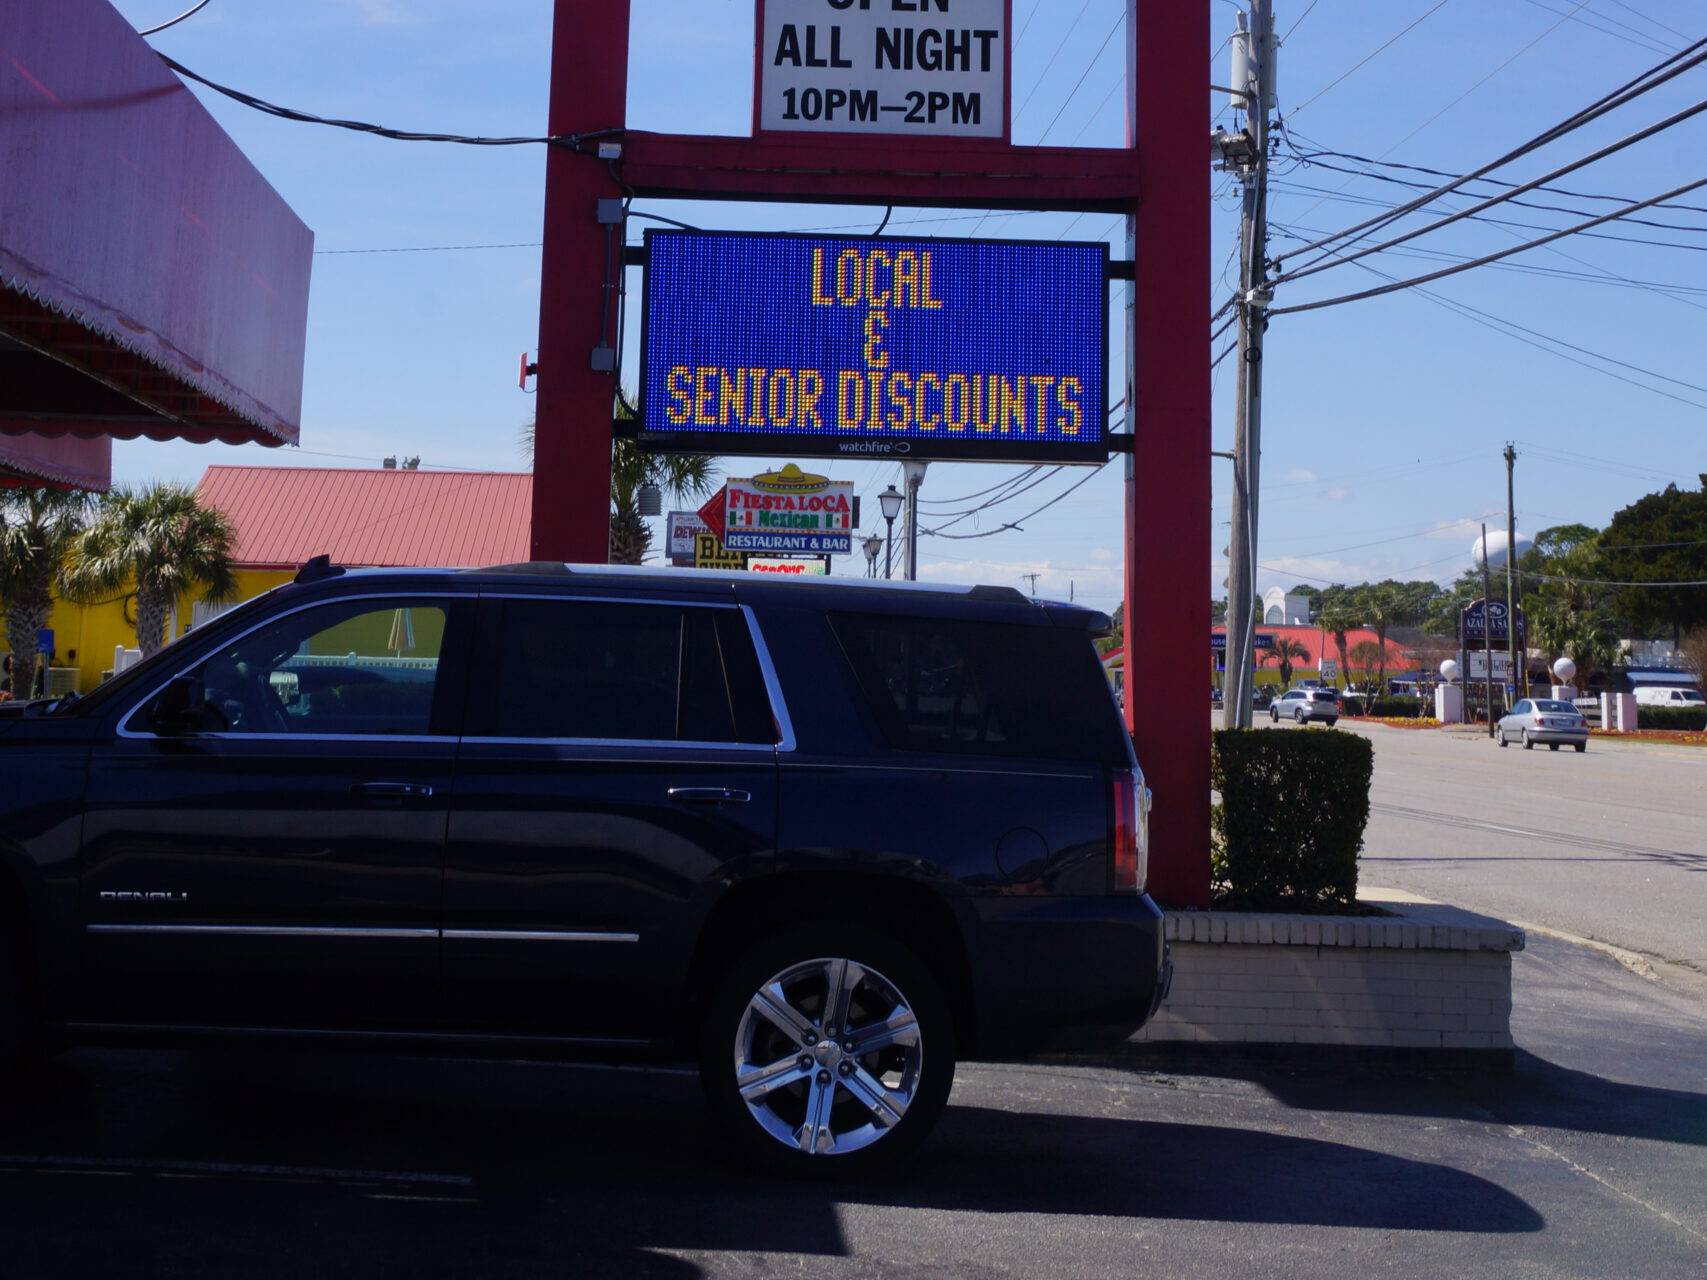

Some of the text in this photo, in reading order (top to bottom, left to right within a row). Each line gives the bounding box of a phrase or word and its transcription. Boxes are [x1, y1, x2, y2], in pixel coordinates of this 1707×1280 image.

[774, 23, 999, 73] ALL NIGHT
[811, 247, 943, 309] LOCAL
[666, 365, 1084, 435] SENIOR DISCOUNTS
[839, 441, 891, 453] watchfire
[728, 489, 850, 512] FIESTA LOCA
[758, 510, 819, 529] Mexican
[728, 535, 848, 550] RESTAURANT & BAR
[1324, 670, 1336, 678] 40
